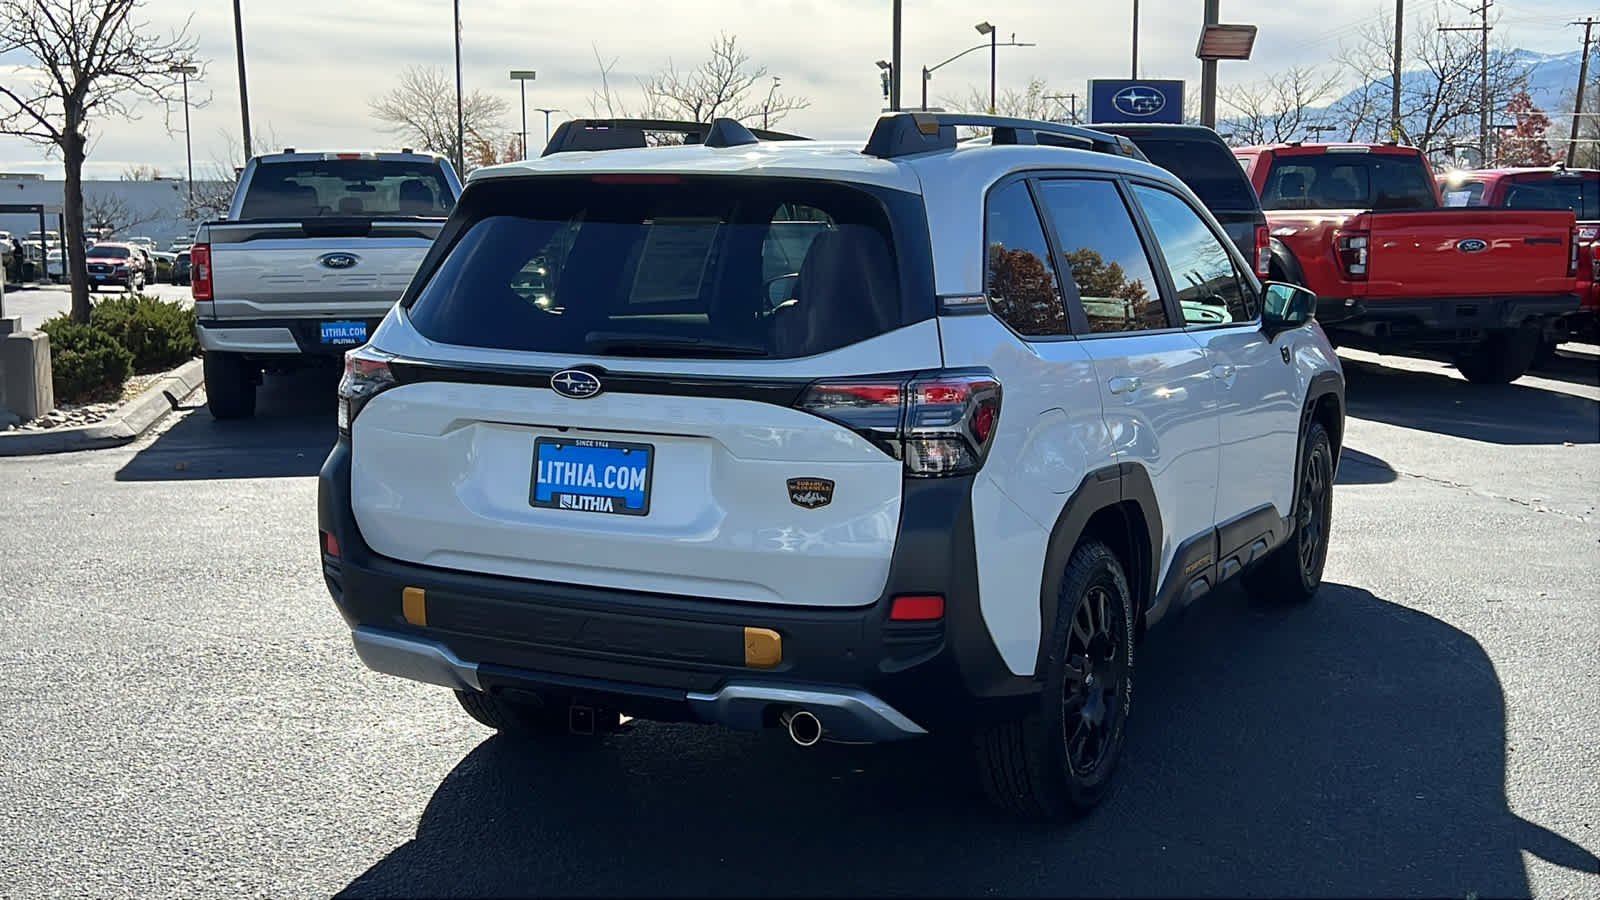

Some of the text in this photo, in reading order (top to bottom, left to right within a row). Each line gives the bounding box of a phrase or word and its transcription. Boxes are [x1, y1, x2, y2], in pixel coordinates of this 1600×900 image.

[321, 327, 367, 338] LITHIA.COM
[575, 440, 594, 448] SINCE
[536, 460, 646, 492] LITHIA.COM
[571, 495, 614, 513] LITHIA
